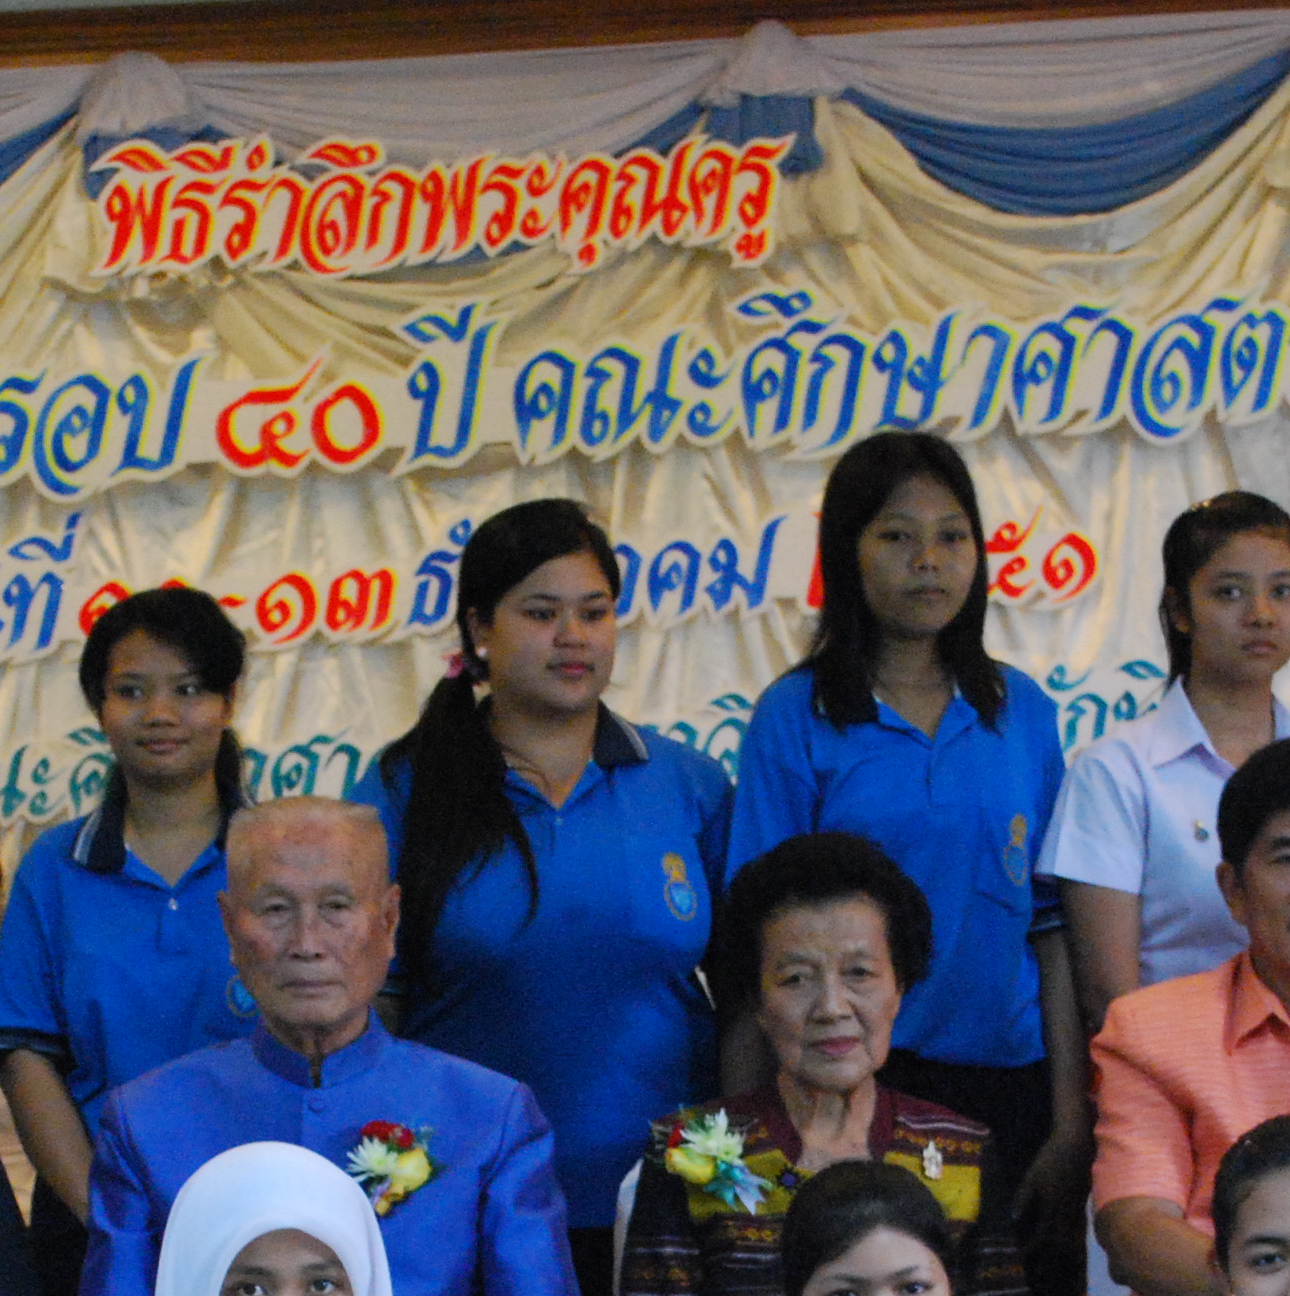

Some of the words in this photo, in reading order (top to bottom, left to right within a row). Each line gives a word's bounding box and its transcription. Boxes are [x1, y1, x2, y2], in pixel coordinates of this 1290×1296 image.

[100, 138, 788, 276] พิธีรำลึกพระคุณครู
[404, 302, 496, 461] ปี
